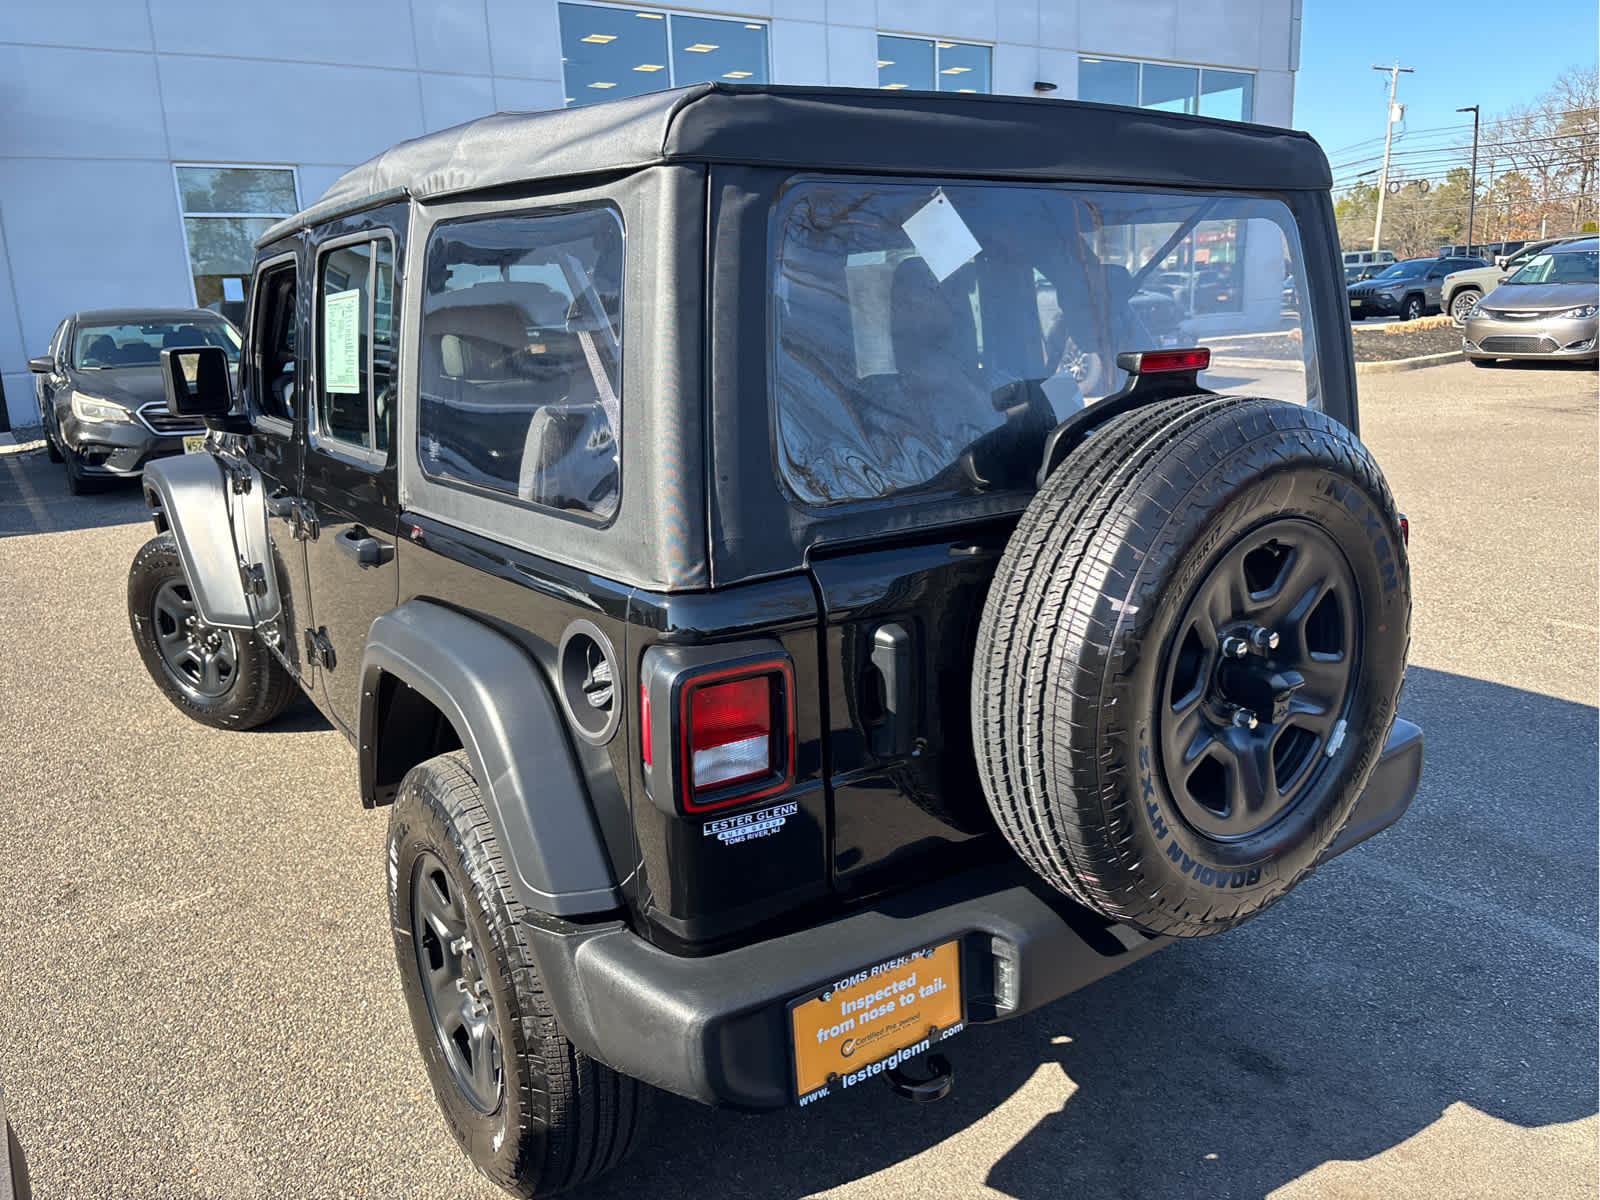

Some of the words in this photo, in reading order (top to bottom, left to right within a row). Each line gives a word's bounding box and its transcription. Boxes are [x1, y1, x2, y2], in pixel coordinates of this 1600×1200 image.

[703, 815, 753, 834] LESTER
[756, 803, 798, 821] GLENN
[721, 828, 746, 839] AUTO
[751, 818, 783, 831] GROUP
[725, 835, 746, 846] TOMS
[771, 826, 781, 834] NJ
[1166, 840, 1262, 889] ROADIAN
[833, 971, 867, 992] TOMS
[911, 949, 926, 961] NJ
[816, 1018, 855, 1044] from
[859, 1001, 895, 1025] nose
[898, 993, 915, 1007] to
[918, 978, 947, 999] tail.
[841, 972, 917, 1016] Inspected
[855, 1028, 884, 1046] Certified
[799, 1087, 831, 1107] www.
[842, 1039, 930, 1089] lesterglenn
[939, 1023, 964, 1041] .com
